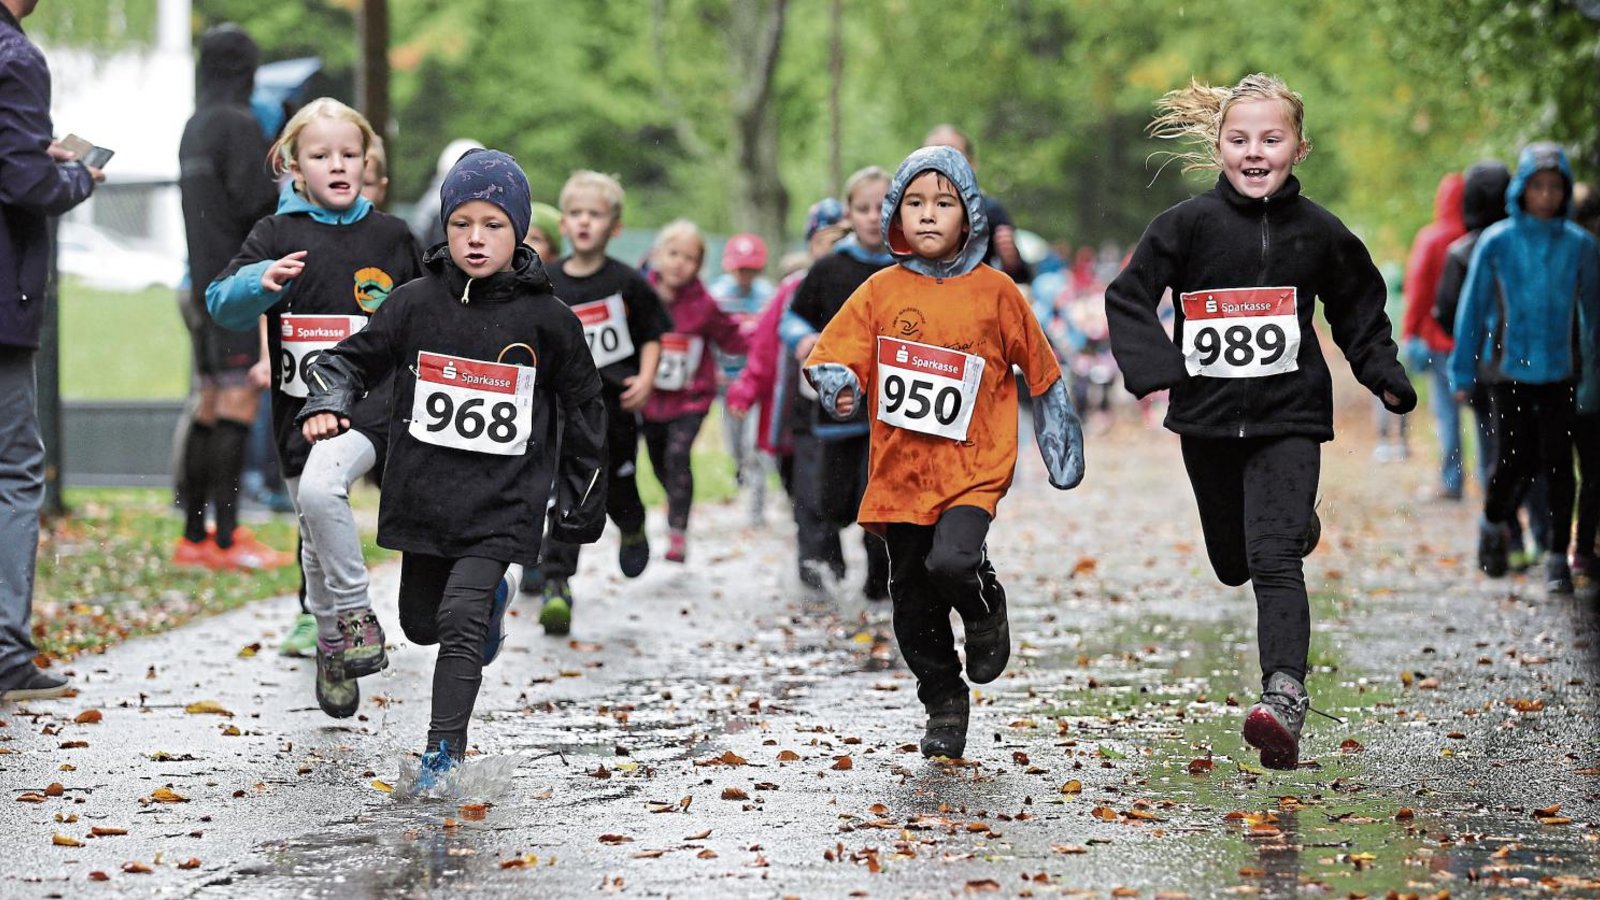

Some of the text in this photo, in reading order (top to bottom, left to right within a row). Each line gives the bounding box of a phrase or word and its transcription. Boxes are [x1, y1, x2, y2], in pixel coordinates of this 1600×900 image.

[1221, 302, 1272, 313] Sparkasse
[297, 328, 345, 338] Sparkasse
[1194, 323, 1286, 366] 989
[911, 356, 959, 374] Sparkasse
[461, 372, 511, 388] Sparkasse
[884, 374, 962, 426] 950
[425, 391, 518, 444] 968
